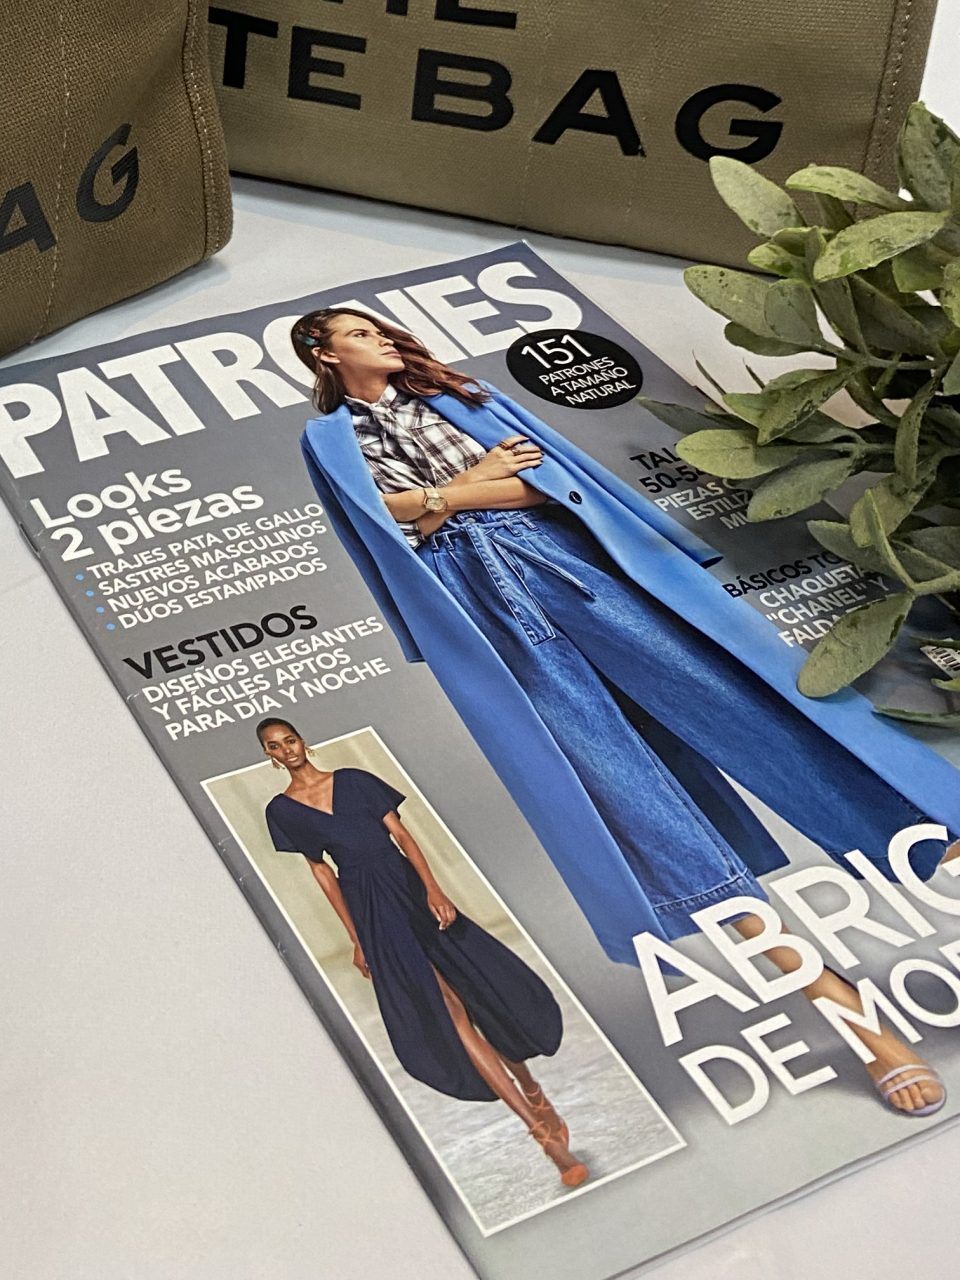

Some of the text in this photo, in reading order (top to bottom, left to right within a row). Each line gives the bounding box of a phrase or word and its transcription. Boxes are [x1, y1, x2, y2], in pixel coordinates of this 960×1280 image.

[208, 6, 784, 165] TE BAG
[521, 334, 592, 369] 151
[538, 356, 615, 385] PATRONES
[550, 367, 628, 397] A TAMAÑO
[565, 380, 637, 405] NATURAL
[629, 443, 682, 470] TAL
[30, 468, 192, 530] Looks
[49, 483, 265, 562] 2 piezas
[653, 481, 724, 512] PIEZAS
[686, 489, 751, 521] ESTILIZ
[86, 503, 324, 579] TRAJES PATA DE GALLO
[98, 520, 327, 596] SASTRES MASCULINOS
[107, 541, 319, 613] NUEVOS ACABADOS
[118, 557, 328, 629] DÚOS ESTAMPADOS
[722, 559, 813, 598] BÁSICOS
[765, 576, 890, 625] "CHANEL" Y
[122, 605, 318, 680] VESTIDOS
[141, 616, 384, 704] DISEÑOS ELEGANTES
[151, 647, 351, 721] Y FÁCILES APTOS
[165, 657, 392, 741] PARA DÍA Y NOCHE
[678, 1012, 838, 1126] DE
